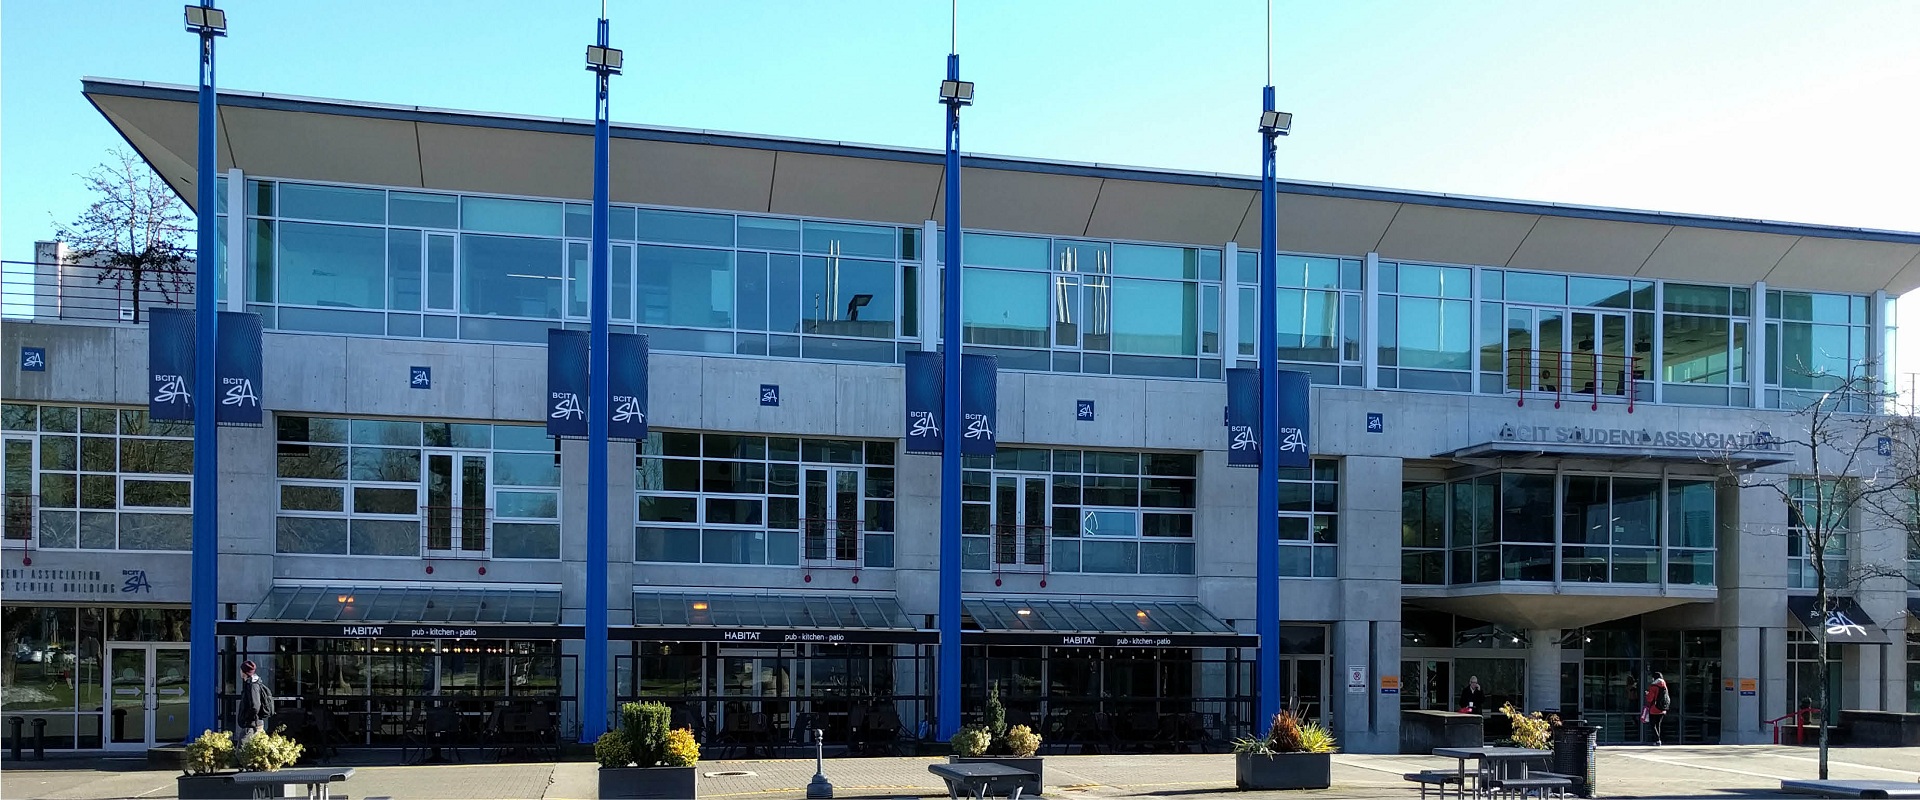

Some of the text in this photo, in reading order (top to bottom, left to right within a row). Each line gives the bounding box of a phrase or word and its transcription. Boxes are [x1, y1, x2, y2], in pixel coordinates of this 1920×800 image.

[154, 375, 191, 404] SA
[155, 374, 177, 382] BCIT
[222, 377, 244, 385] BCIT
[221, 378, 258, 407] SA
[551, 393, 584, 421] SA
[612, 397, 645, 424] SA
[909, 411, 939, 438] SA
[964, 414, 993, 440] SA
[1231, 426, 1257, 451] SA
[1280, 428, 1307, 453] SA
[1502, 425, 1781, 451] BCIT STUDENT ASSOCIATION
[15, 582, 54, 592] CENTRE
[121, 570, 152, 593] SA
[343, 626, 477, 638] HABITAT pub kitchen patio
[724, 631, 845, 643] HABITAT pub kitchen patio
[1063, 636, 1171, 647] HABITAT pub kitchen patio
